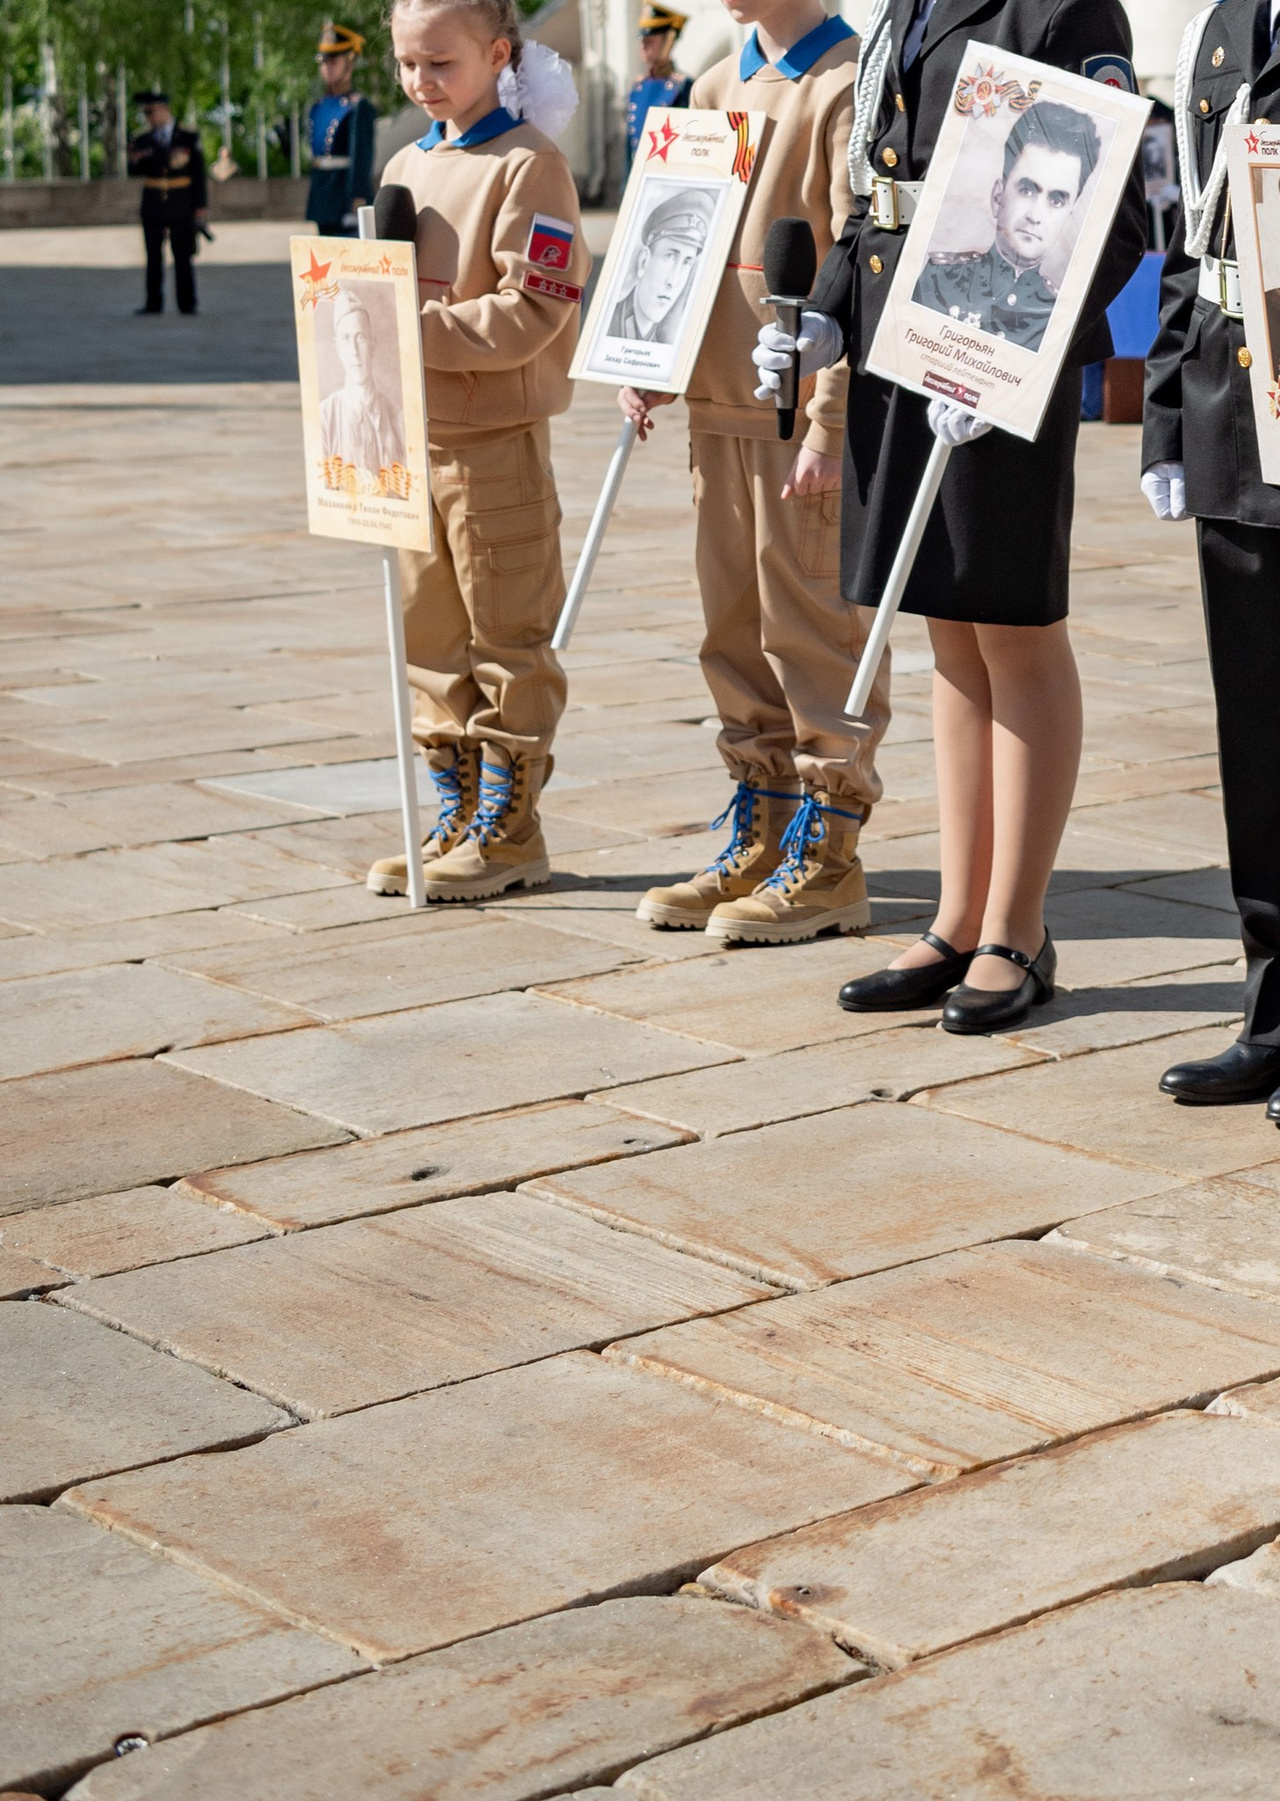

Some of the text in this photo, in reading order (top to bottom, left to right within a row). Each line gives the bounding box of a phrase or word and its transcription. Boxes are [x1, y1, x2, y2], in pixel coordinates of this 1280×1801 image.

[621, 345, 651, 356] Григорьев
[939, 324, 996, 357] Григорьян
[904, 328, 1022, 387] Григорий Михайлович
